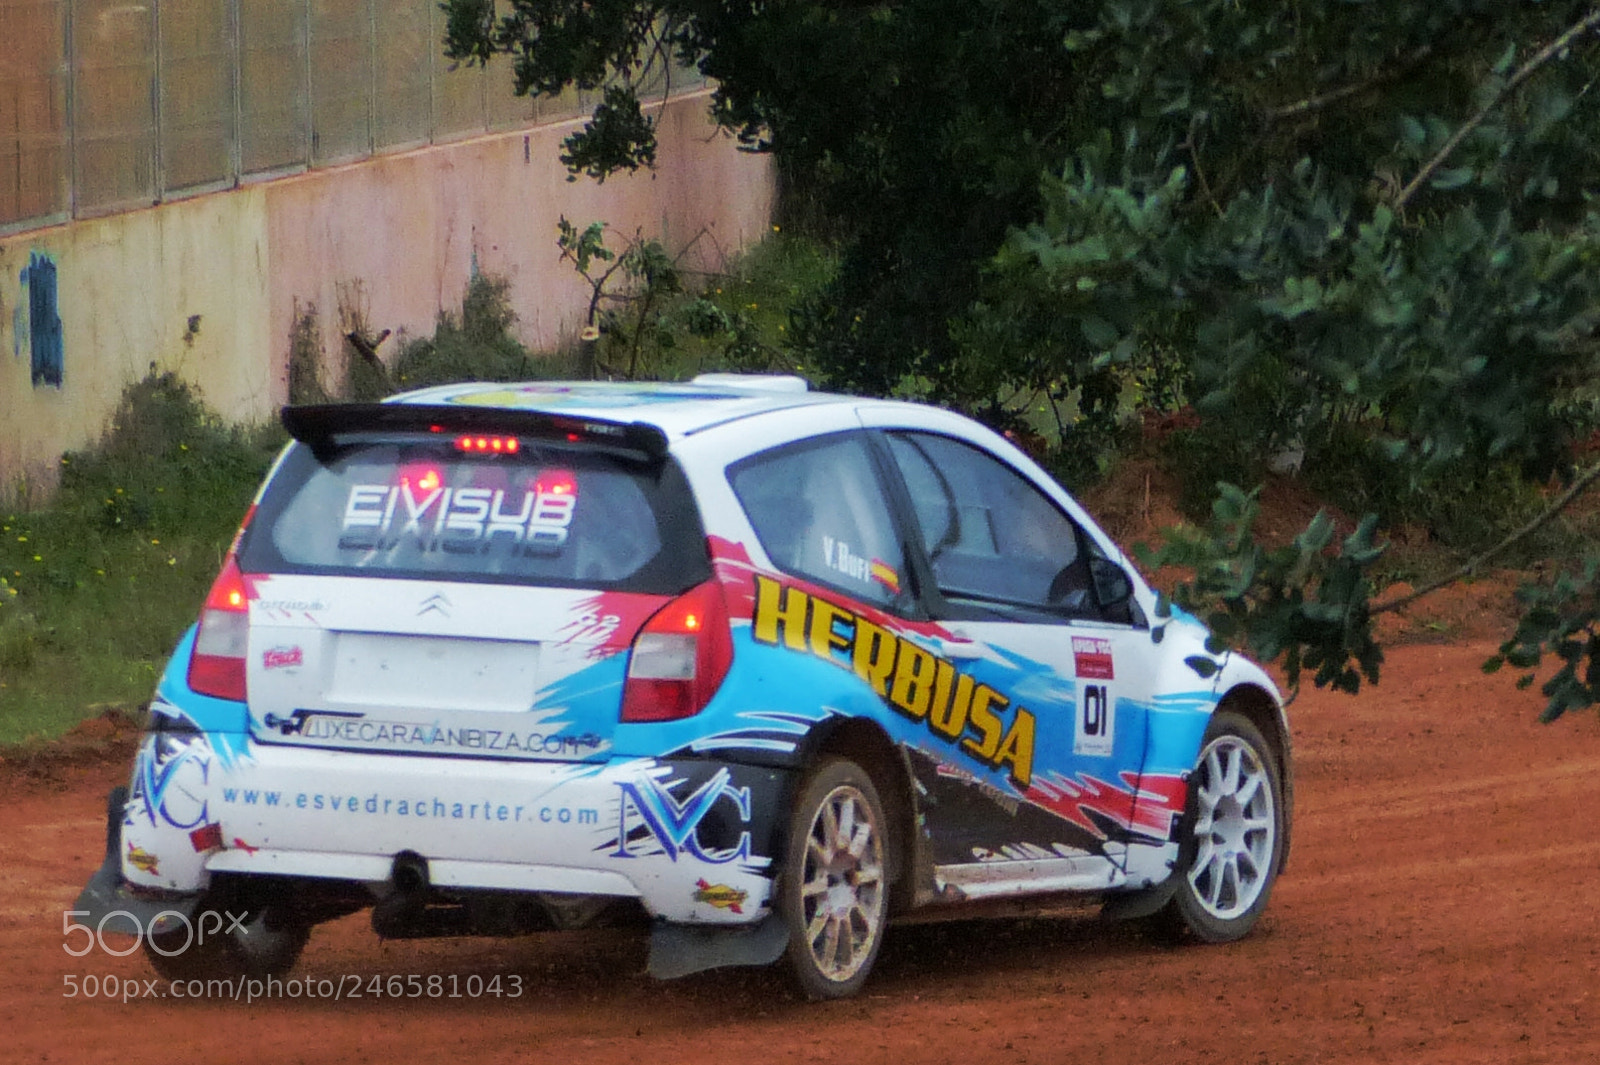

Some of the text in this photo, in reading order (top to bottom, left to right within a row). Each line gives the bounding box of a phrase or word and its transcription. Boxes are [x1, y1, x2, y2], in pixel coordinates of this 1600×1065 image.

[753, 573, 1036, 788] HERBUSA
[1083, 684, 1107, 737] 01
[222, 786, 599, 825] www.esvedracharter.com
